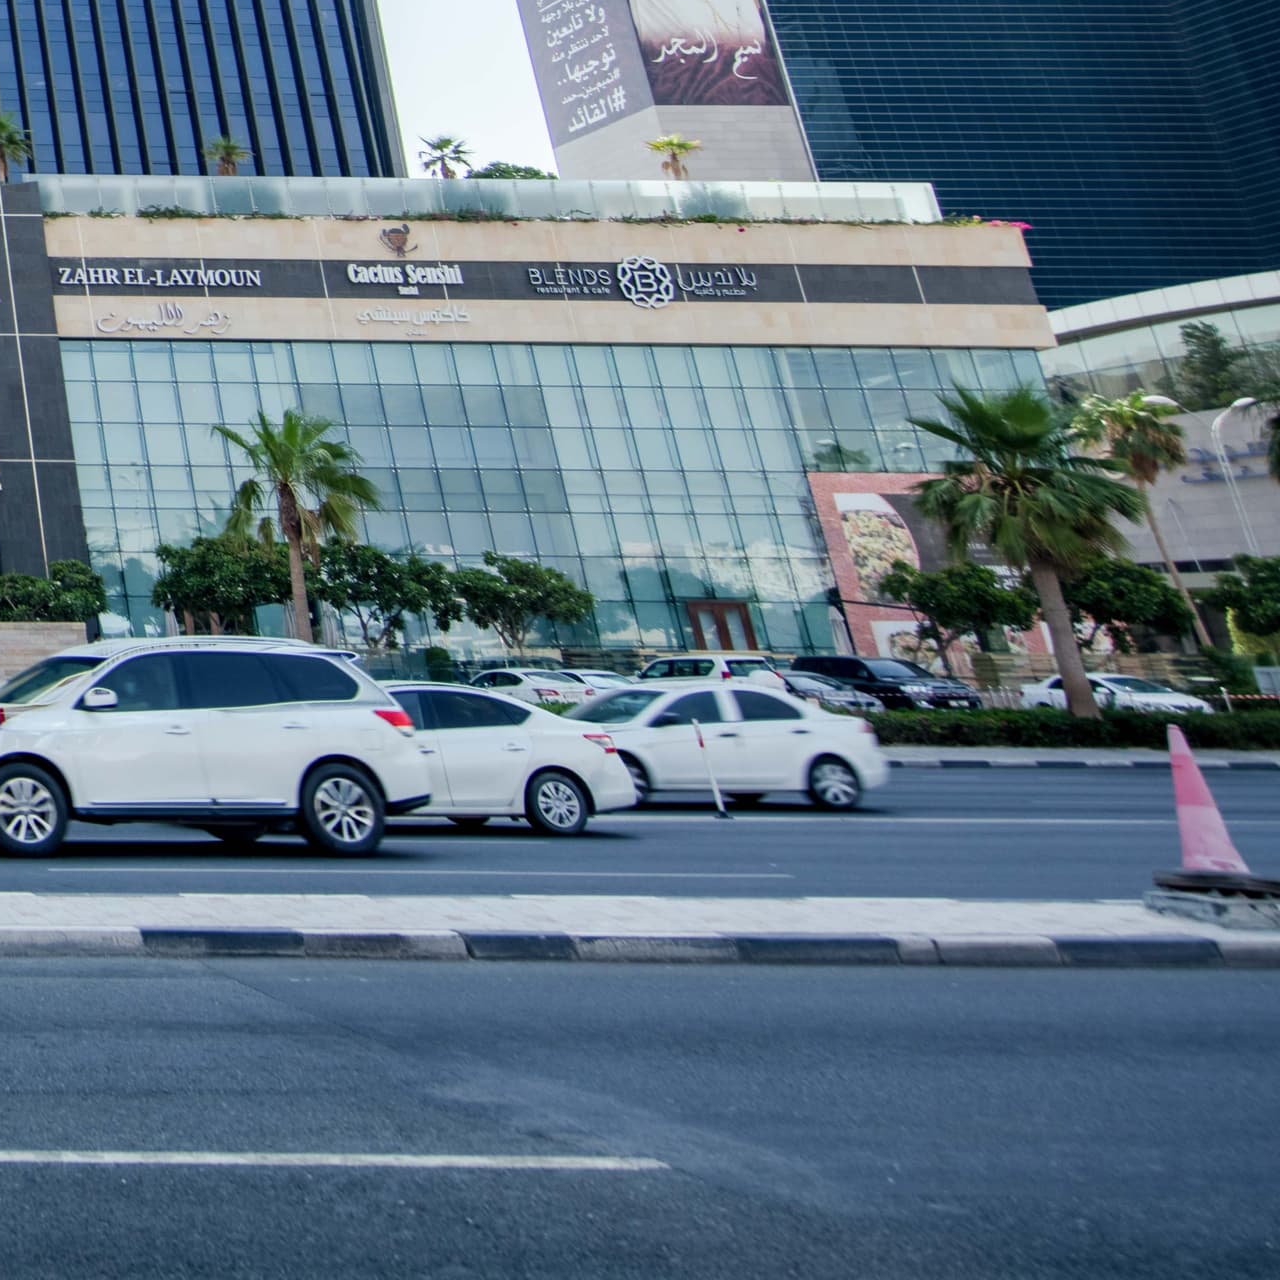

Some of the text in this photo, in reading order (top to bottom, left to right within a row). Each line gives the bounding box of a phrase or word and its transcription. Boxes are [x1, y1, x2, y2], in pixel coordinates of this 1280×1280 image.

[547, 3, 605, 47] ولا تابعين
[58, 267, 262, 287] ZAHR EL-LAYMOUN
[347, 263, 464, 284] Cactus Senshi
[528, 268, 612, 285] BLENDS
[536, 286, 580, 294] restaurant
